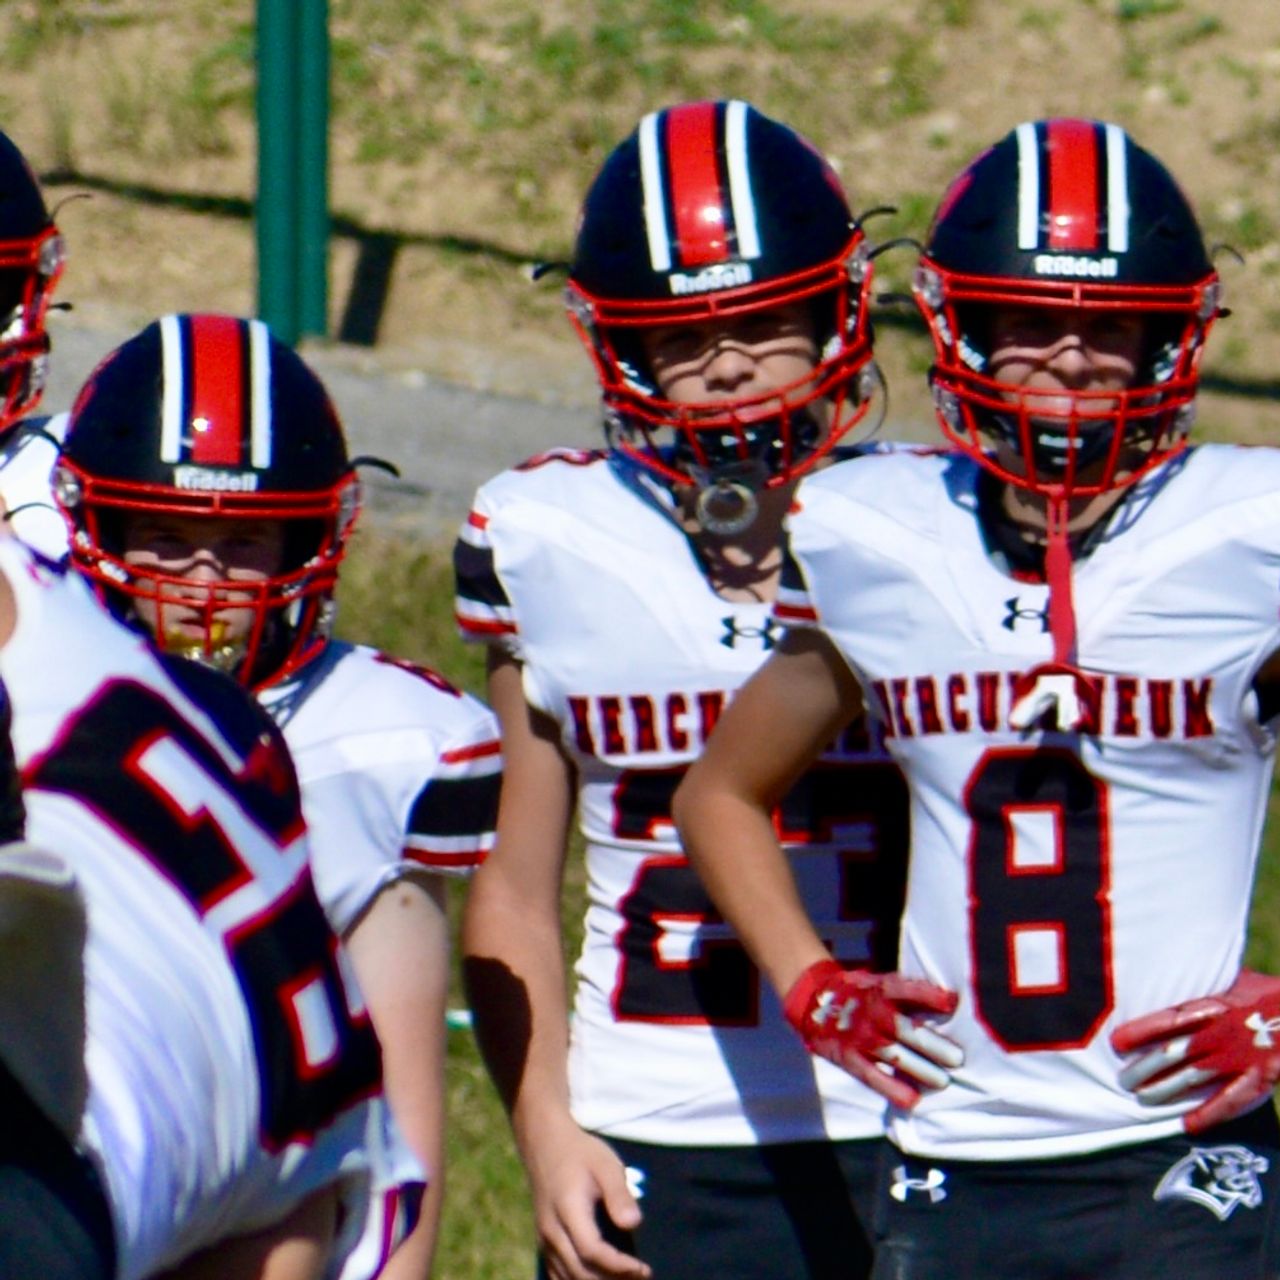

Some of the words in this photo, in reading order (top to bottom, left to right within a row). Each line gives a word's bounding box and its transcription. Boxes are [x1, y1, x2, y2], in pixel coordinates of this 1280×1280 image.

[669, 262, 754, 296] Riddell
[1034, 254, 1118, 278] Riddell
[174, 465, 258, 492] Riddell
[963, 746, 1115, 1053] 8
